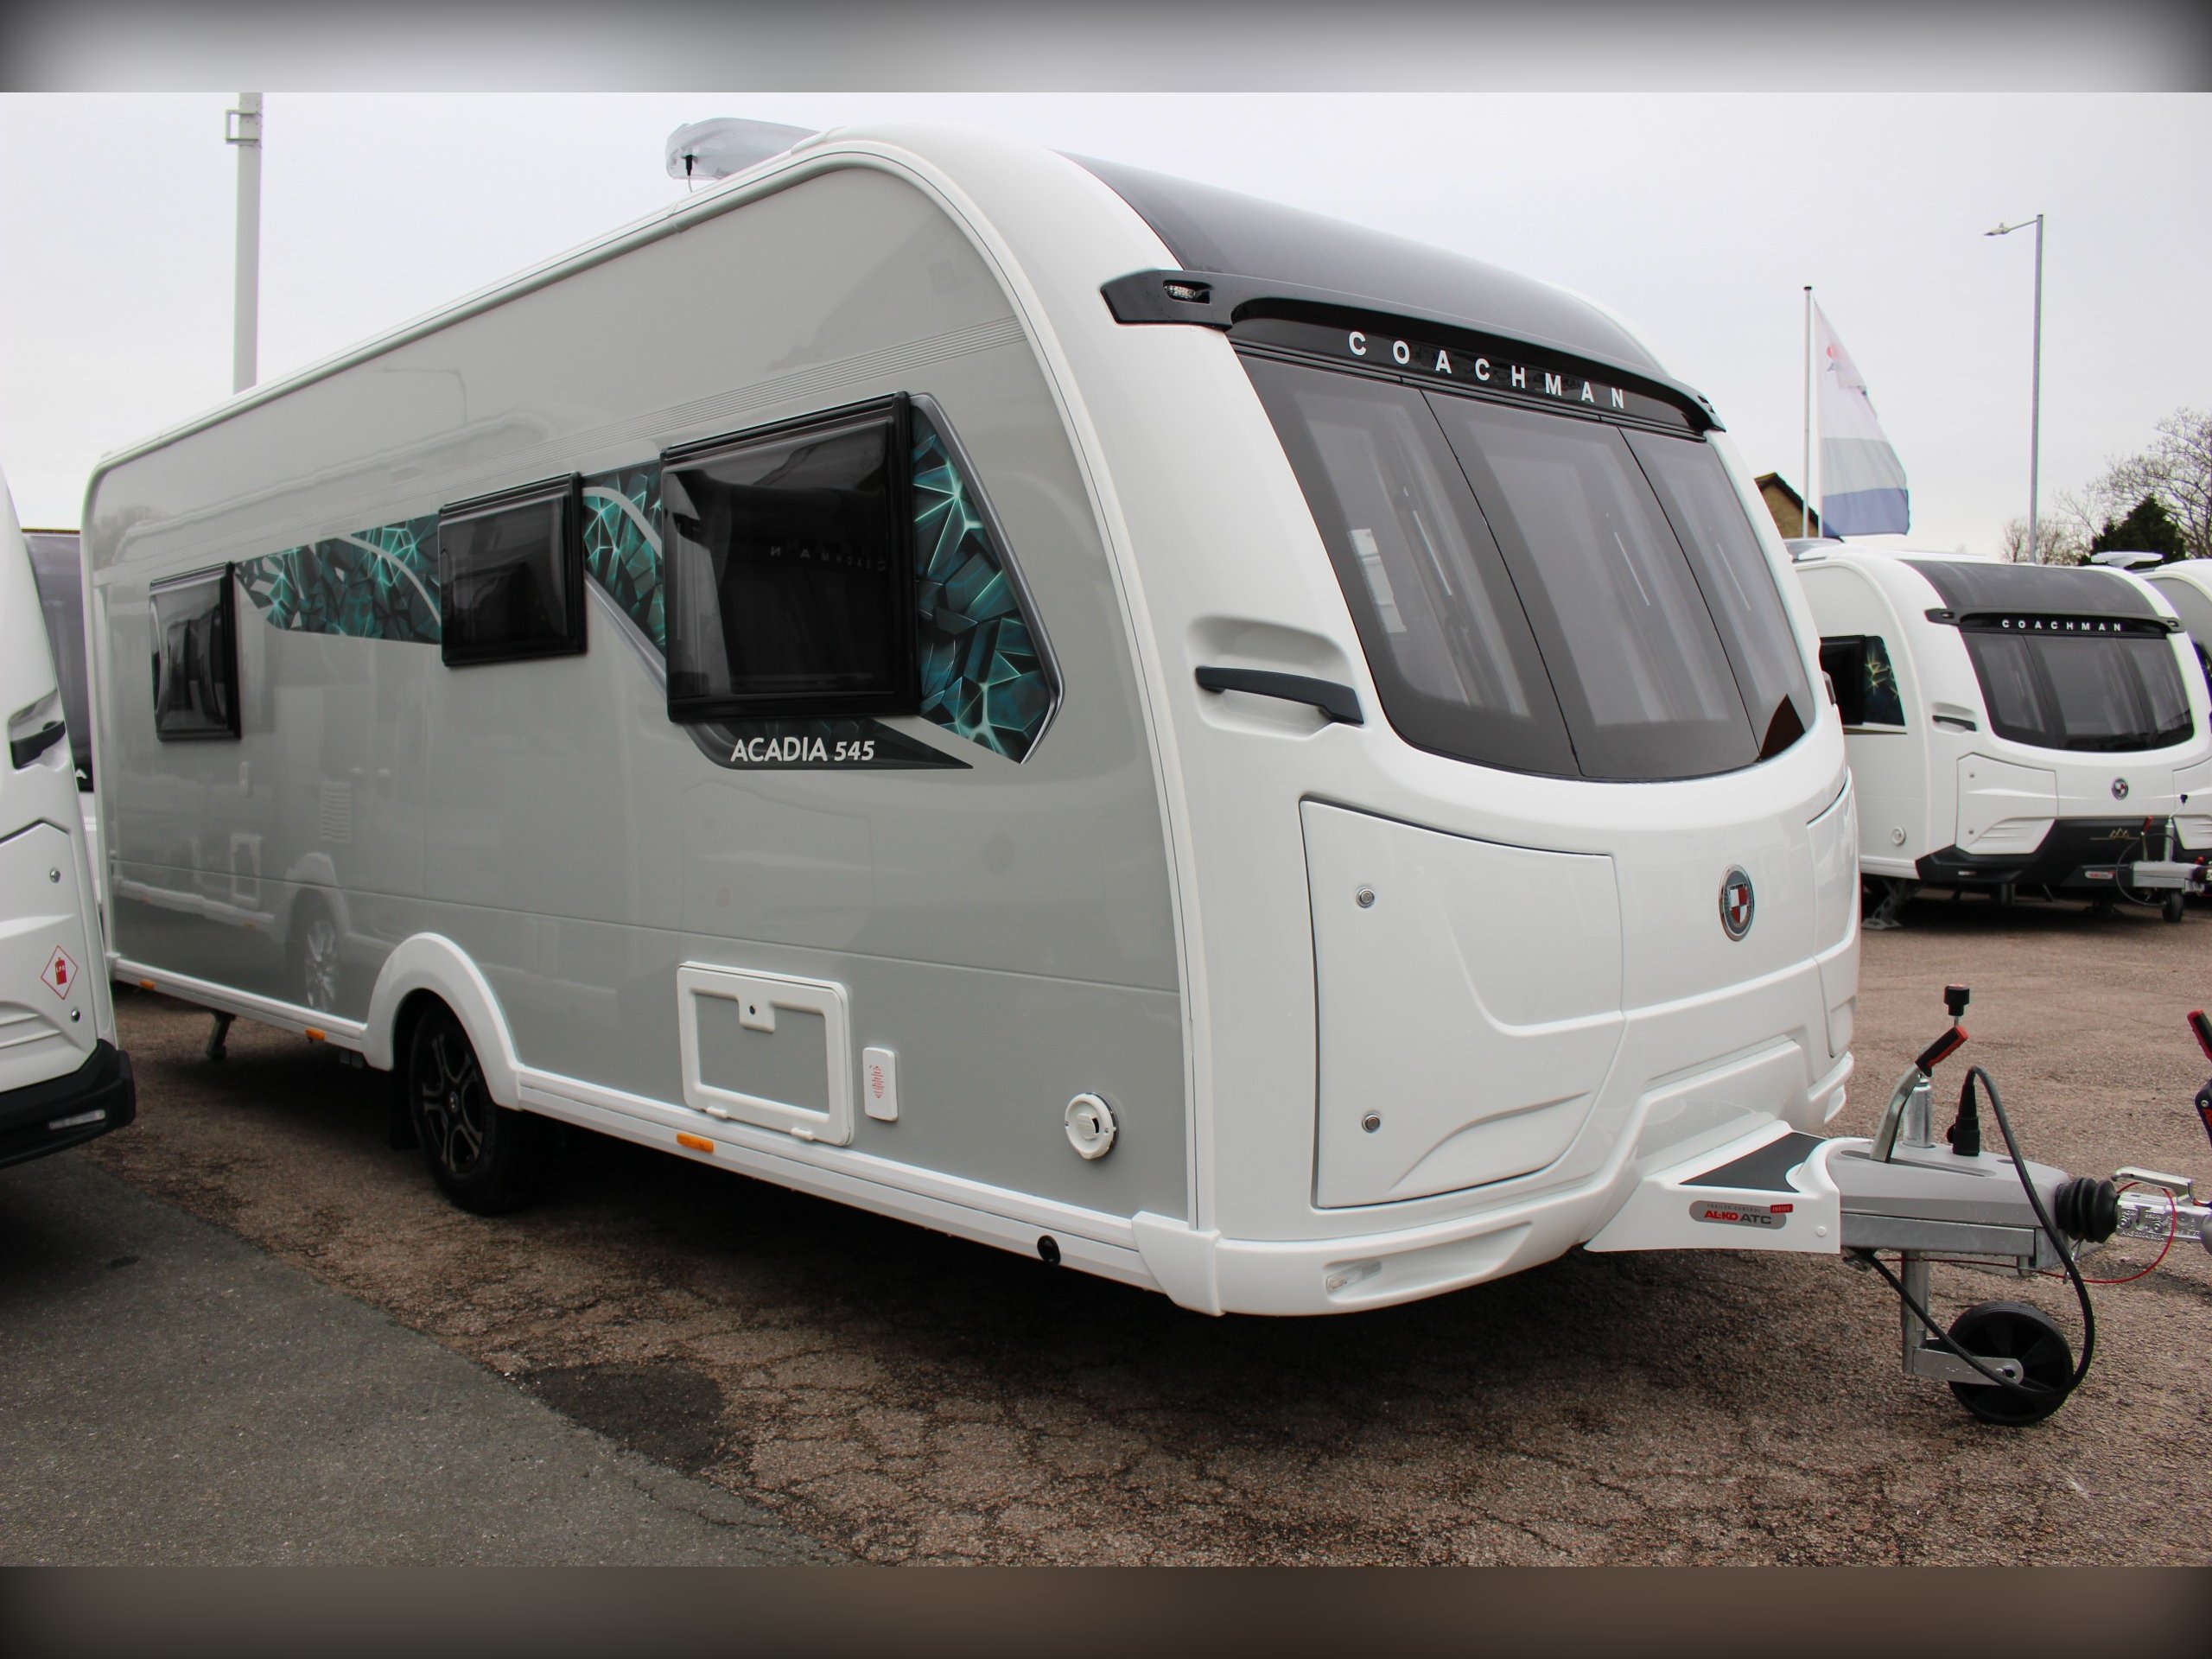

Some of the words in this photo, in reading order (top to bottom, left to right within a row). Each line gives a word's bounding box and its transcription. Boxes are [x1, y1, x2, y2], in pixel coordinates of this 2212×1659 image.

[1348, 331, 1624, 409] COACHMAN
[2002, 619, 2121, 632] COACHMAN
[730, 737, 828, 762] ACADIA
[834, 741, 875, 761] 545
[1740, 1213, 1772, 1224] ATC
